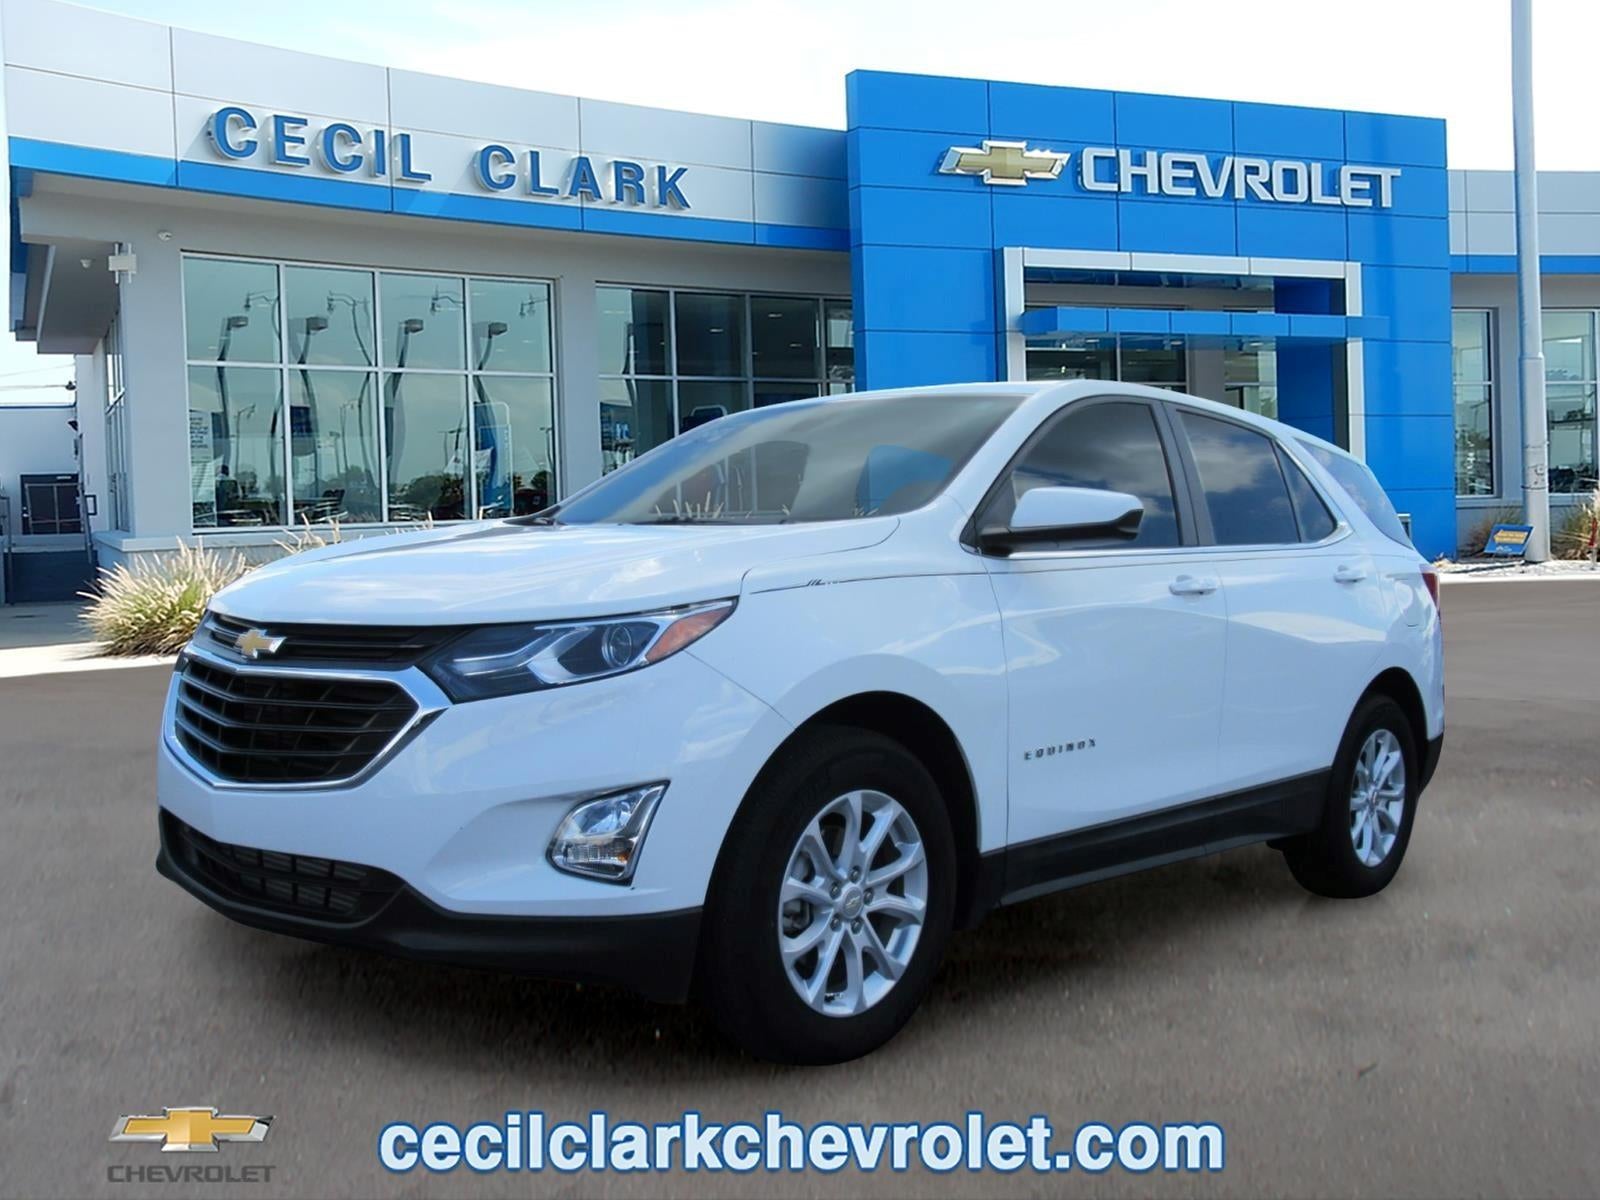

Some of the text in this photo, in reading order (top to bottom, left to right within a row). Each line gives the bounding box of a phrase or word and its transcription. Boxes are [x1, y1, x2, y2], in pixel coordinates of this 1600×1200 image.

[209, 106, 692, 209] CECIL CLARK
[1080, 147, 1401, 208] CHEVROLET
[1024, 738, 1096, 761] EQUINOX
